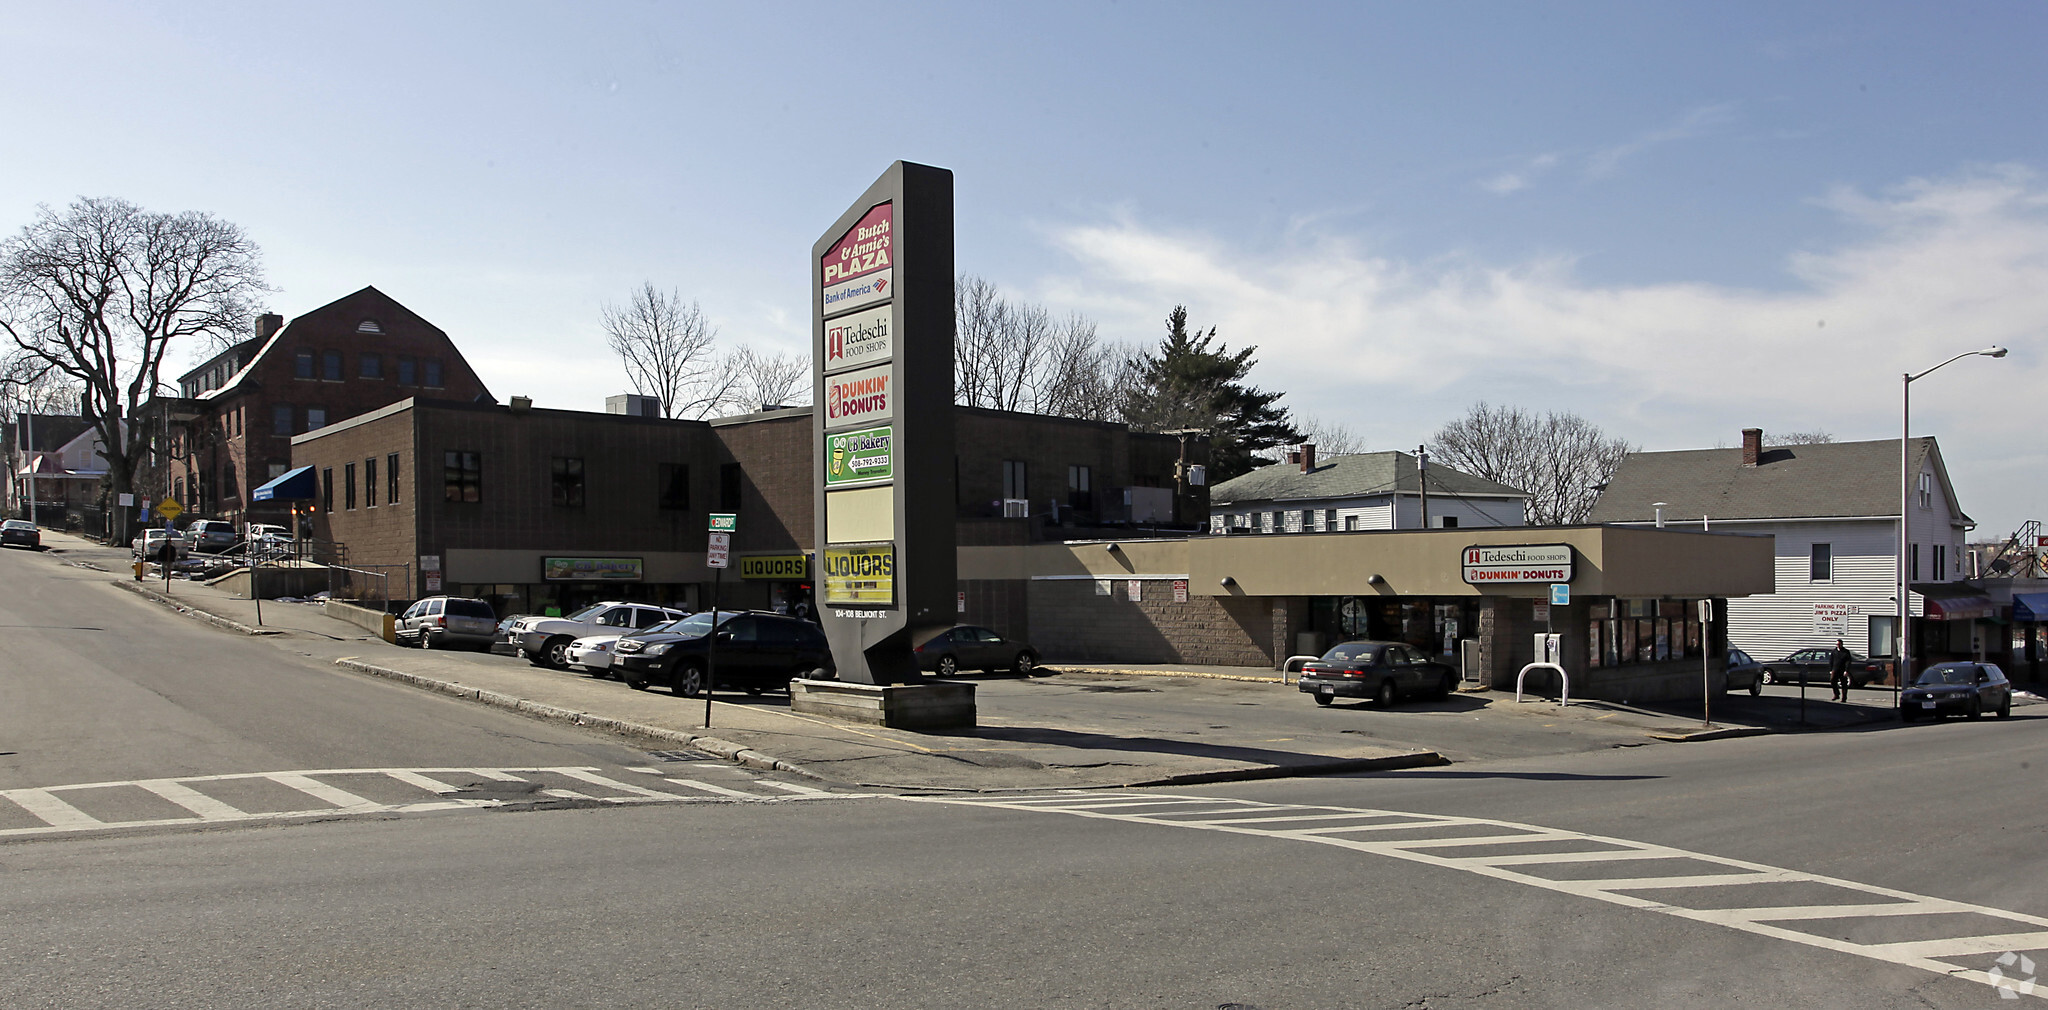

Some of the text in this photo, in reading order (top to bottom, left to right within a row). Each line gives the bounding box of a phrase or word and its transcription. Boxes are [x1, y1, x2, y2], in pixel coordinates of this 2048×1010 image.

[857, 219, 890, 242] Butch
[851, 235, 890, 258] Annie's
[825, 249, 889, 283] PLAZA
[825, 284, 871, 304] Bank of America
[843, 318, 888, 346] Tedeschi
[845, 340, 887, 358] FOOD SHOPS
[842, 375, 888, 399] DUNKIN'
[842, 394, 886, 416] DONUTS
[847, 432, 890, 453] CB Bakery
[851, 456, 888, 468] 508-792-9333
[827, 554, 892, 577] LIQUORS
[1482, 550, 1526, 562] Tedeschi
[575, 561, 637, 572] CB Bakery
[743, 559, 803, 575] LIQUORS
[1479, 569, 1564, 580] DUNKIN' DONUTS
[854, 610, 877, 618] BELMONT
